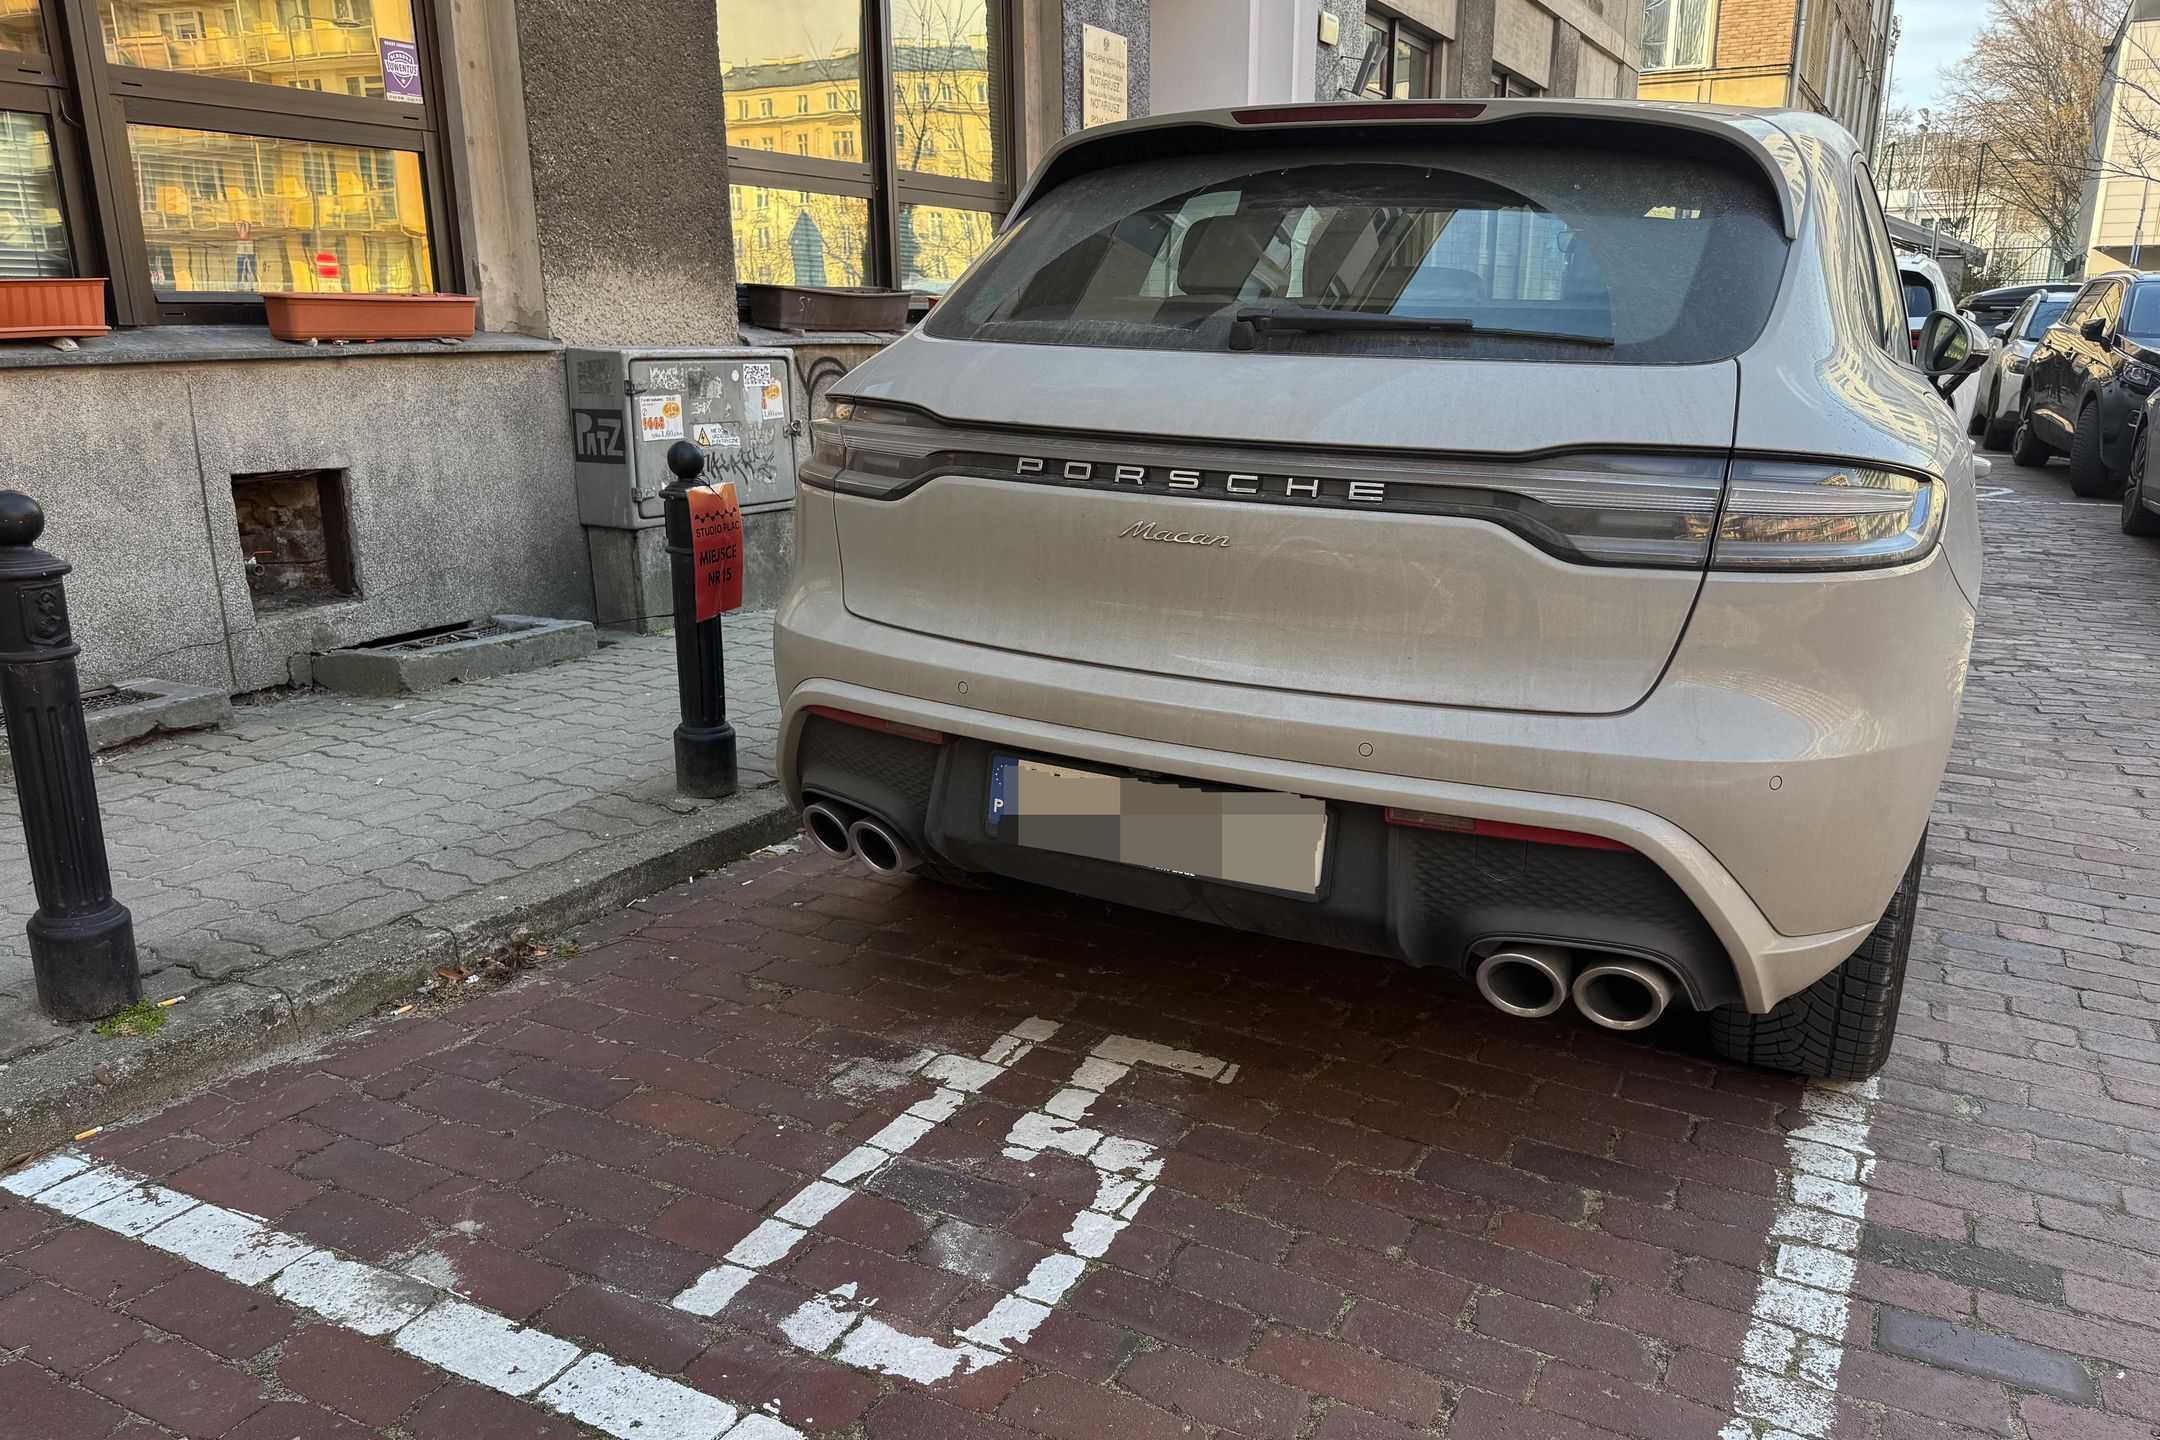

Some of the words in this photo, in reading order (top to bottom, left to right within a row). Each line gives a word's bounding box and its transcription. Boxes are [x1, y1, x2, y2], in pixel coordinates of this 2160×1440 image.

[1090, 75, 1120, 92] NOTARIUSZ
[1090, 98, 1120, 114] NOTARIUSZ
[1016, 456, 1385, 502] PORSCHE
[696, 523, 722, 538] STUDIO
[722, 520, 740, 533] PLAC
[1119, 519, 1231, 548] Macan
[700, 544, 737, 566] MIEJSCE
[708, 570, 721, 587] NR
[722, 567, 732, 583] 15
[993, 797, 1004, 813] P
